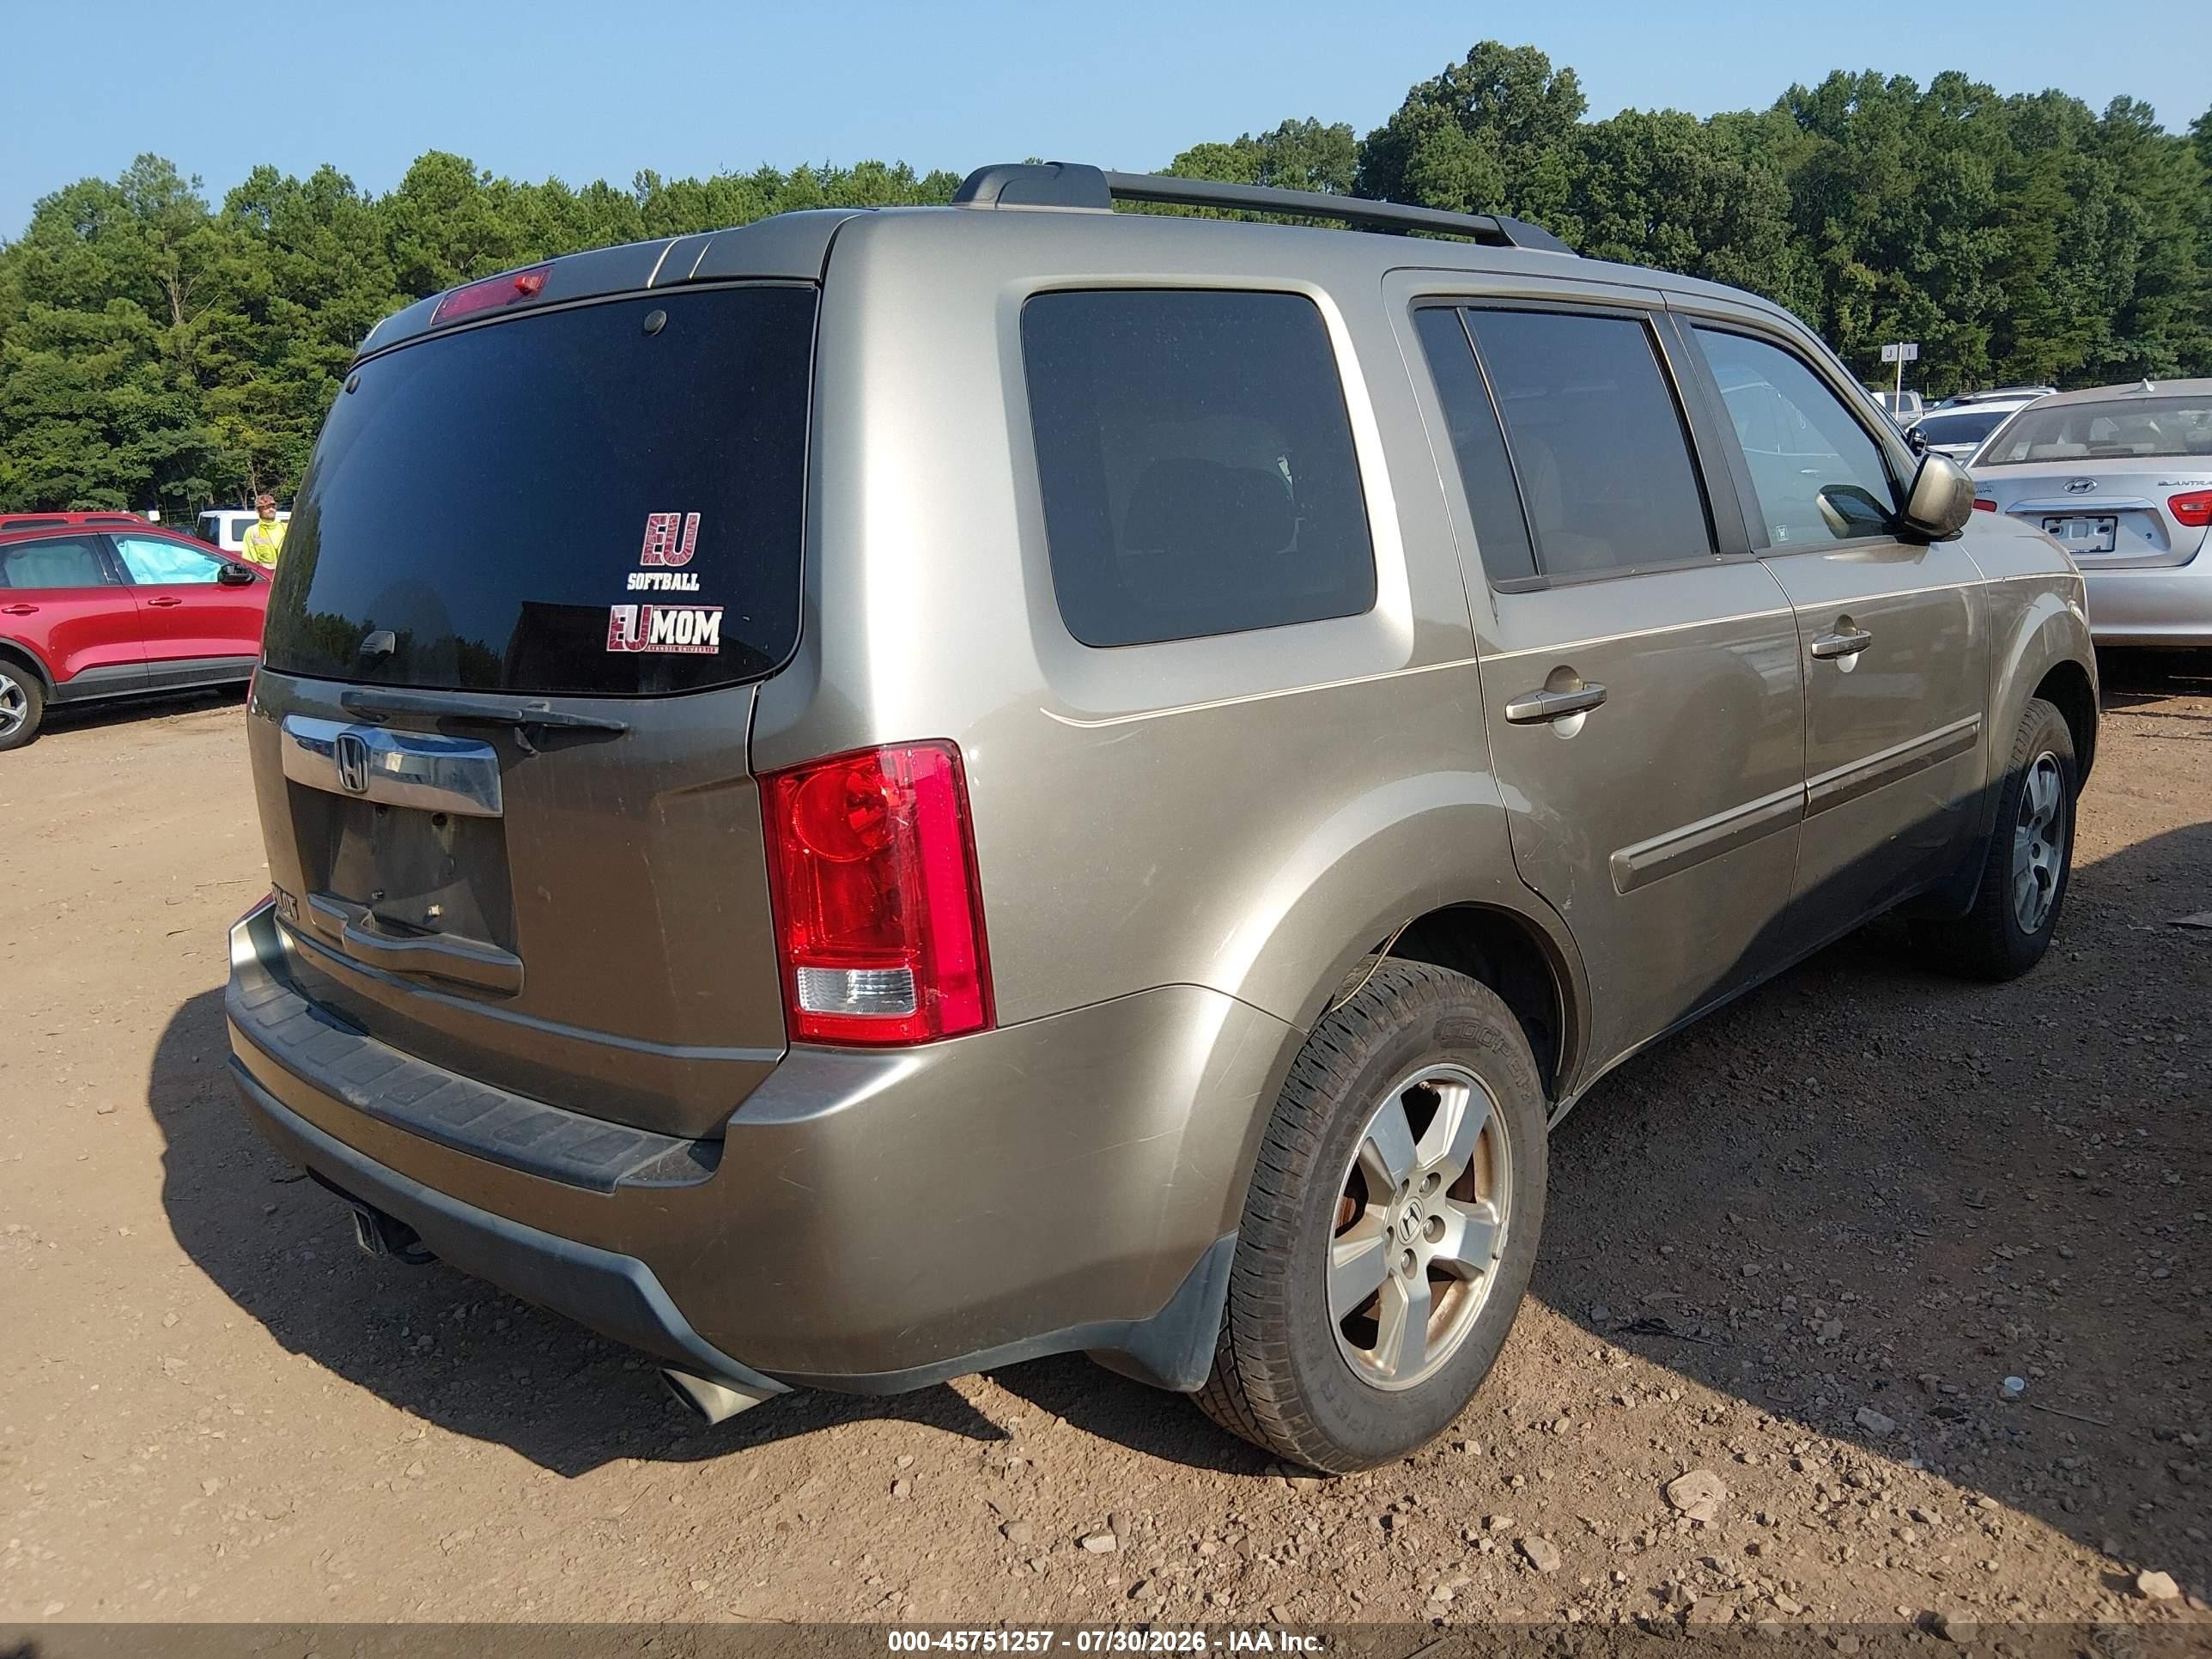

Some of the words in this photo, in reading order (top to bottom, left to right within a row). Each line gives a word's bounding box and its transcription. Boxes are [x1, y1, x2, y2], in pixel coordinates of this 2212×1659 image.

[640, 513, 701, 567] EU
[627, 573, 701, 591] SOFTBALL
[606, 605, 654, 653] EU
[650, 611, 722, 646] MOM
